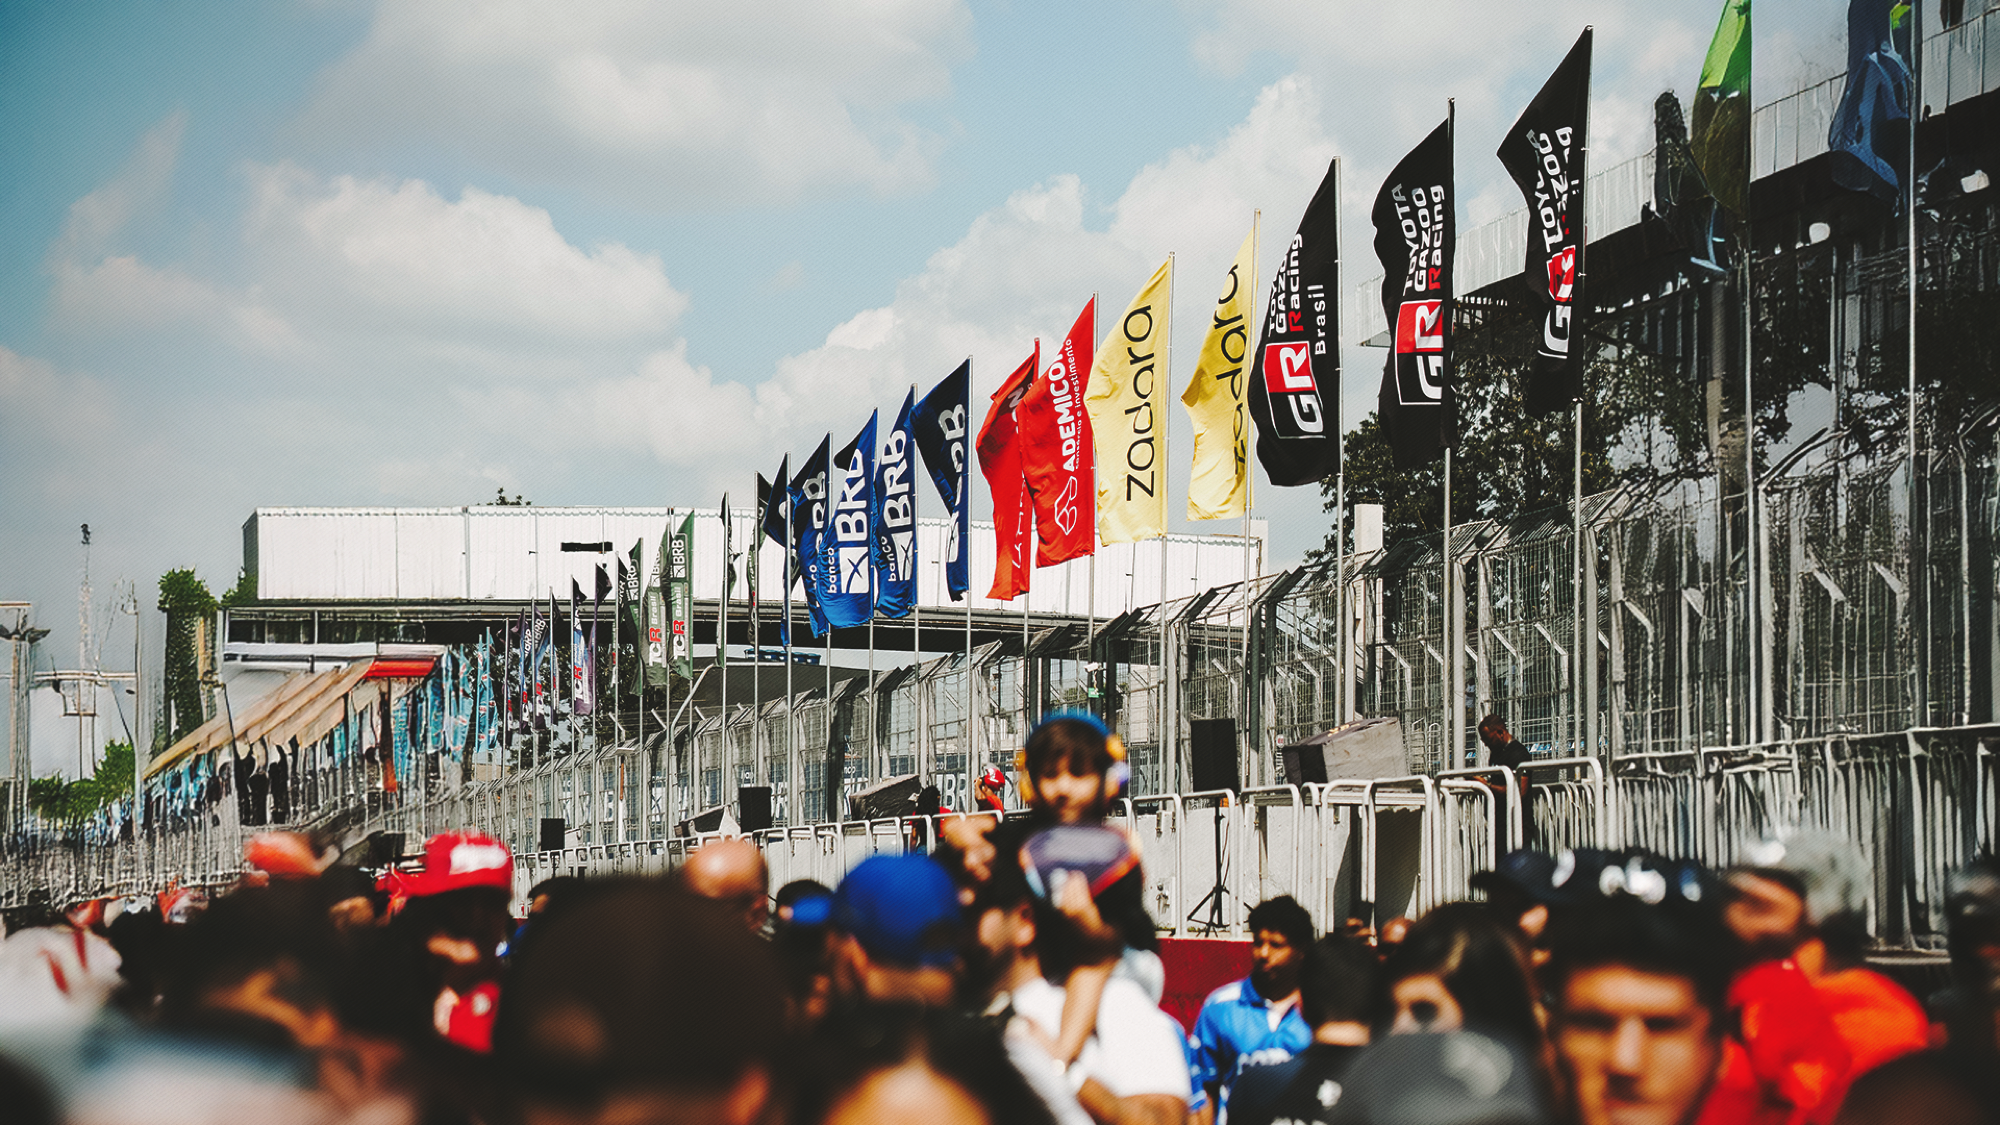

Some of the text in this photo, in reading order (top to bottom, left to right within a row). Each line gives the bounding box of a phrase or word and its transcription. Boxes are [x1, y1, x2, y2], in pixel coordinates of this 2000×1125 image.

[1391, 182, 1419, 297] TOYOTA
[1411, 187, 1431, 292] GAZOO
[1428, 184, 1445, 290] Racing
[1287, 233, 1304, 332] Racing
[1307, 284, 1327, 355] Brasil
[1064, 338, 1083, 408] investimento
[1280, 345, 1324, 434] GR
[1415, 303, 1443, 400] GR
[1122, 304, 1157, 502] zadara
[881, 429, 912, 529] BRB
[672, 538, 685, 565] BRB
[827, 547, 838, 594] banco
[881, 536, 897, 582] banco
[649, 627, 662, 667] TCR
[673, 619, 685, 660] TCR
